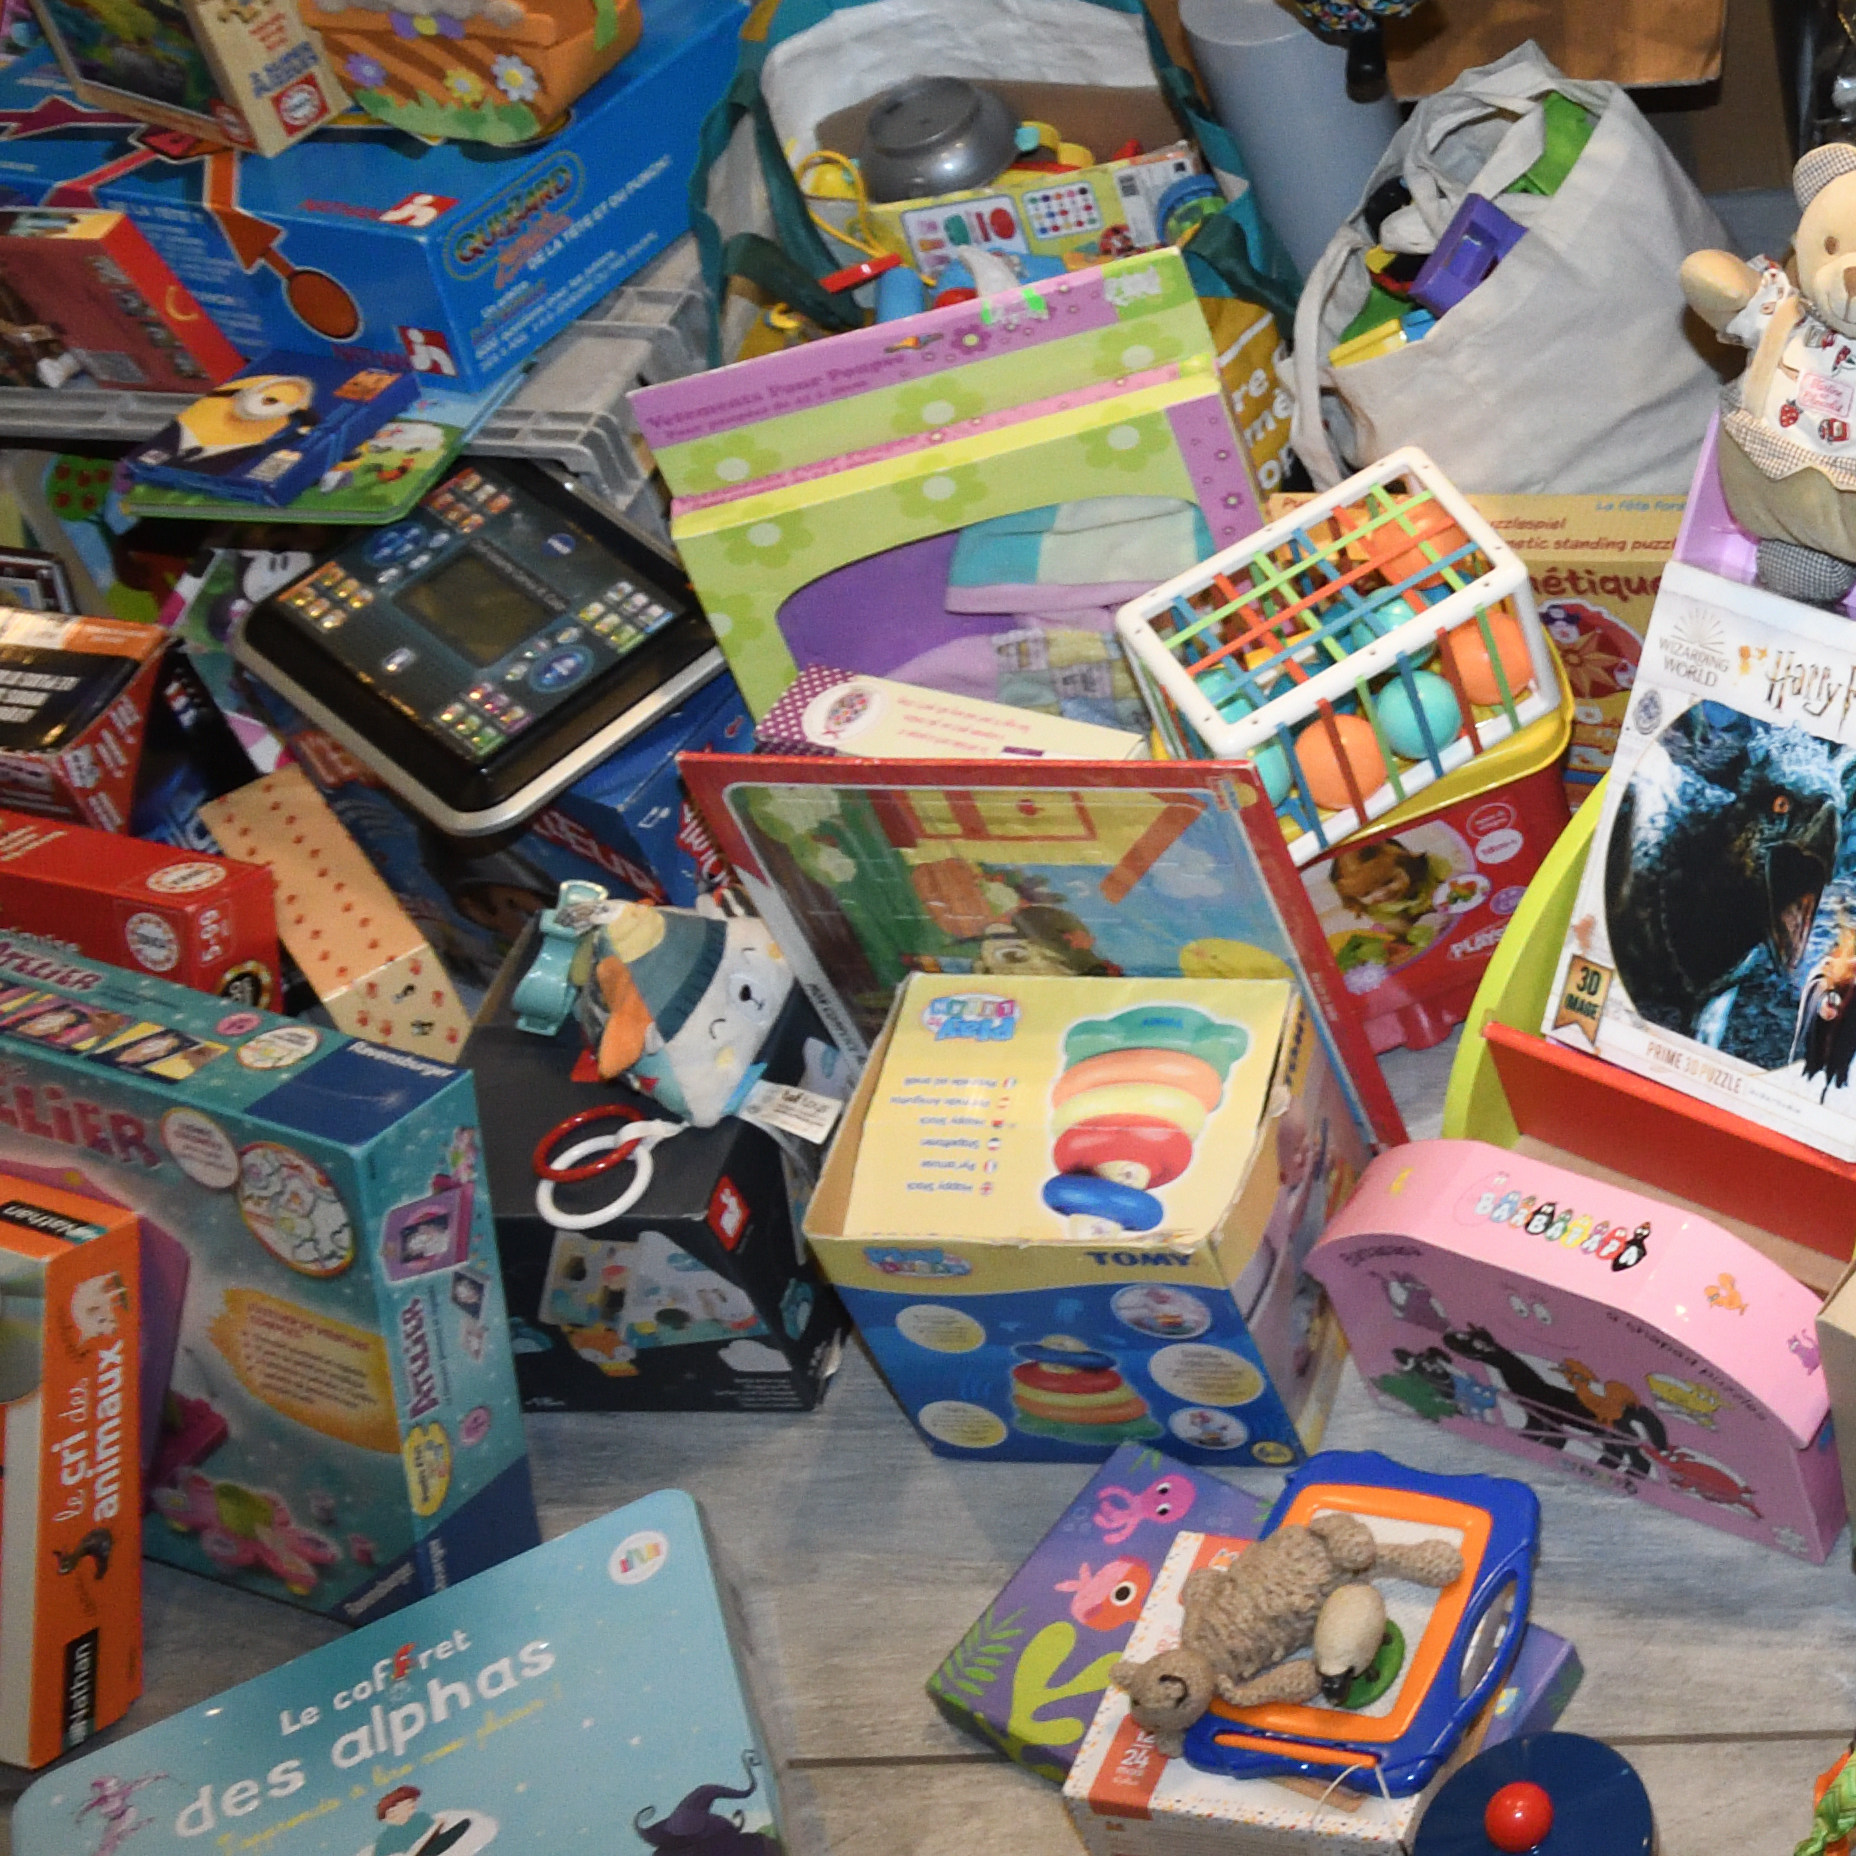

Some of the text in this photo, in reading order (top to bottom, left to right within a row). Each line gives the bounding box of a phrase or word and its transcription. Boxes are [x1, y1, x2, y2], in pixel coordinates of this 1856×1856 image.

[1553, 536, 1626, 553] standing
[1659, 637, 1731, 674] WIZARDING
[1662, 655, 1719, 688] WORLD
[1764, 649, 1844, 718] Harry
[1576, 965, 1601, 996] 3D
[1563, 993, 1601, 1020] IMAGE
[1647, 1041, 1744, 1095] PRIME PUZZLE
[1474, 1189, 1650, 1272] BARBAPAPA
[1088, 1250, 1194, 1268] TOMY
[92, 1339, 124, 1525] animaux
[51, 1433, 88, 1488] cri
[67, 1641, 92, 1725] Nathan
[279, 1704, 321, 1737] Le
[173, 1758, 306, 1841] des
[329, 1638, 558, 1773] alphas
[1120, 1747, 1150, 1769] 24
